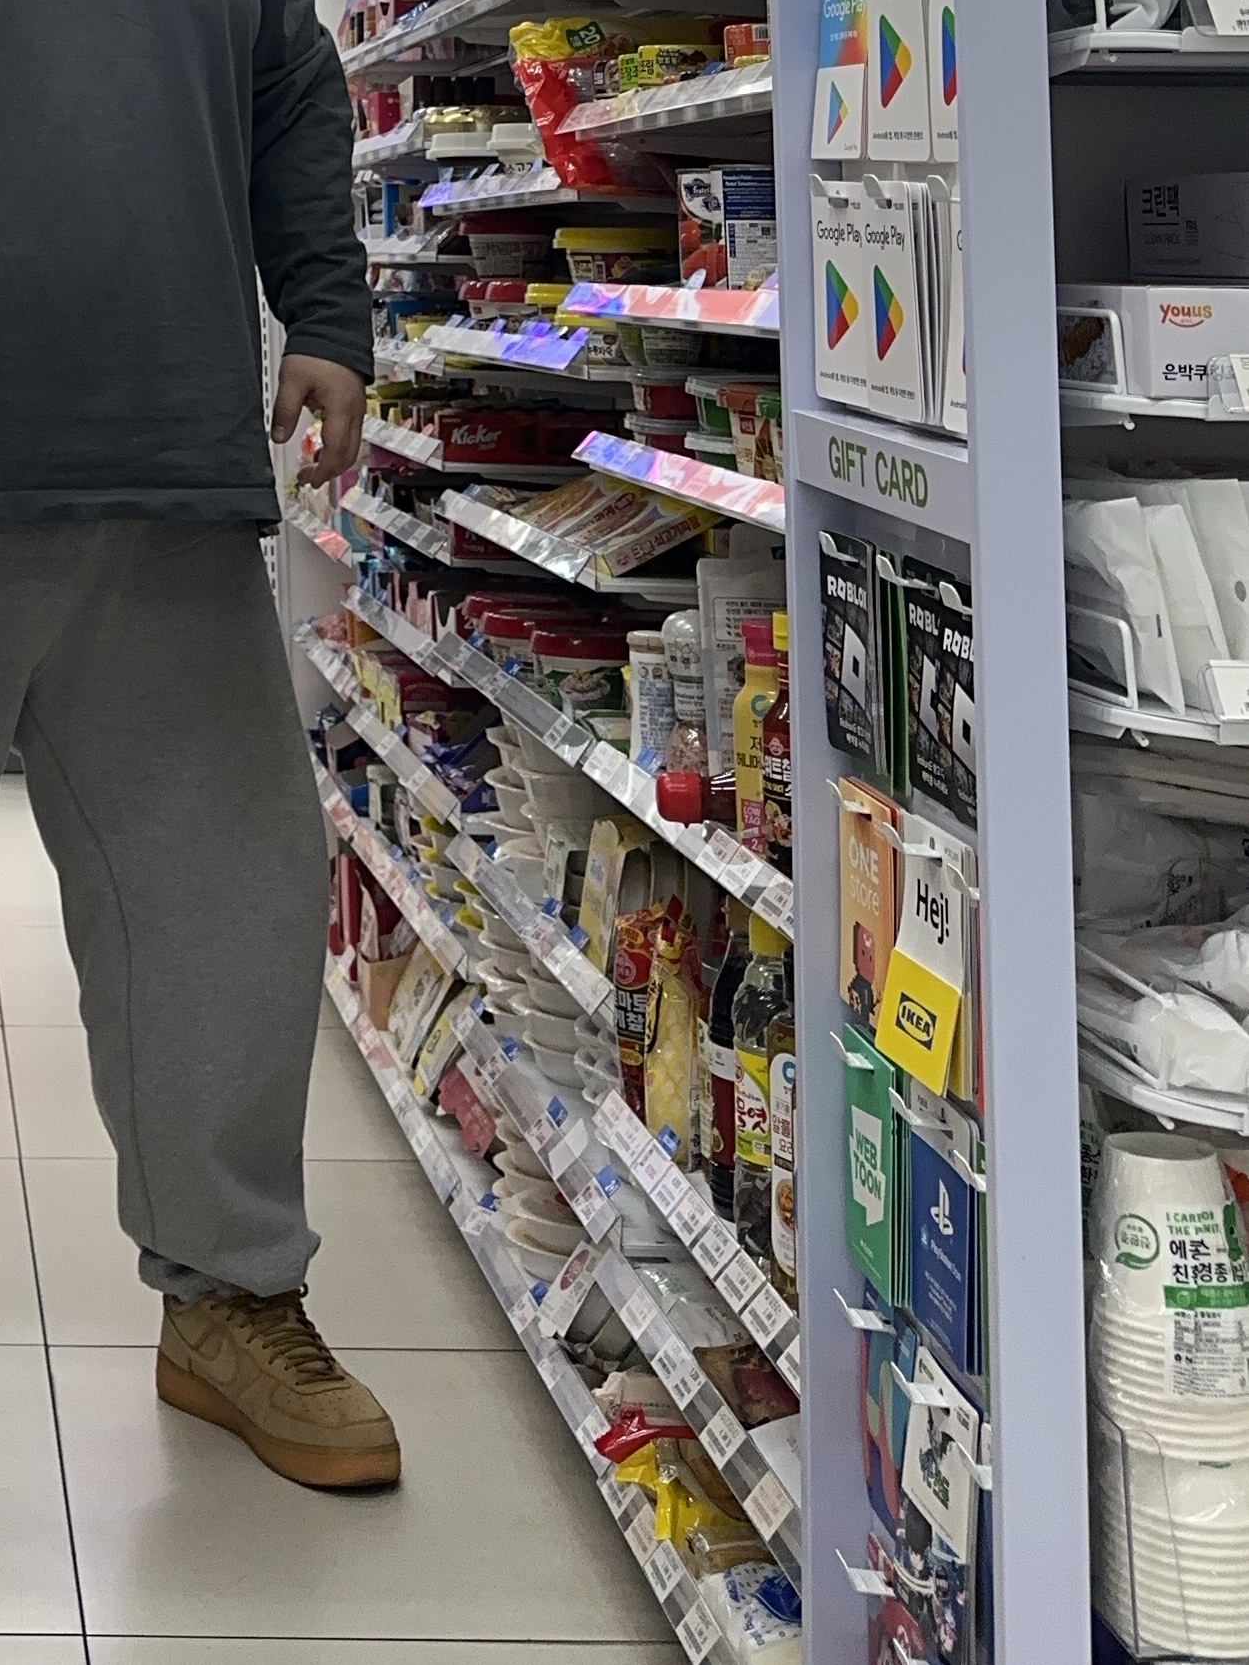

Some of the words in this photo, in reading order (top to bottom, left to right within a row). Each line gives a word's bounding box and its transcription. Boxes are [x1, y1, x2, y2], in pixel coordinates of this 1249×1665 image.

[1142, 185, 1180, 218] 크린팩
[816, 219, 846, 248] Google
[846, 222, 863, 249] Play
[864, 223, 890, 251] Google
[890, 225, 905, 252] Play
[450, 423, 502, 446] Kicker
[828, 436, 868, 487] GIFT
[875, 450, 929, 509] CARD
[849, 836, 880, 885] ONE
[849, 873, 881, 917] store
[916, 878, 950, 945] Hej!
[900, 1003, 932, 1038] IKEA
[855, 1128, 878, 1171] WEB
[853, 1150, 882, 1201] TOON
